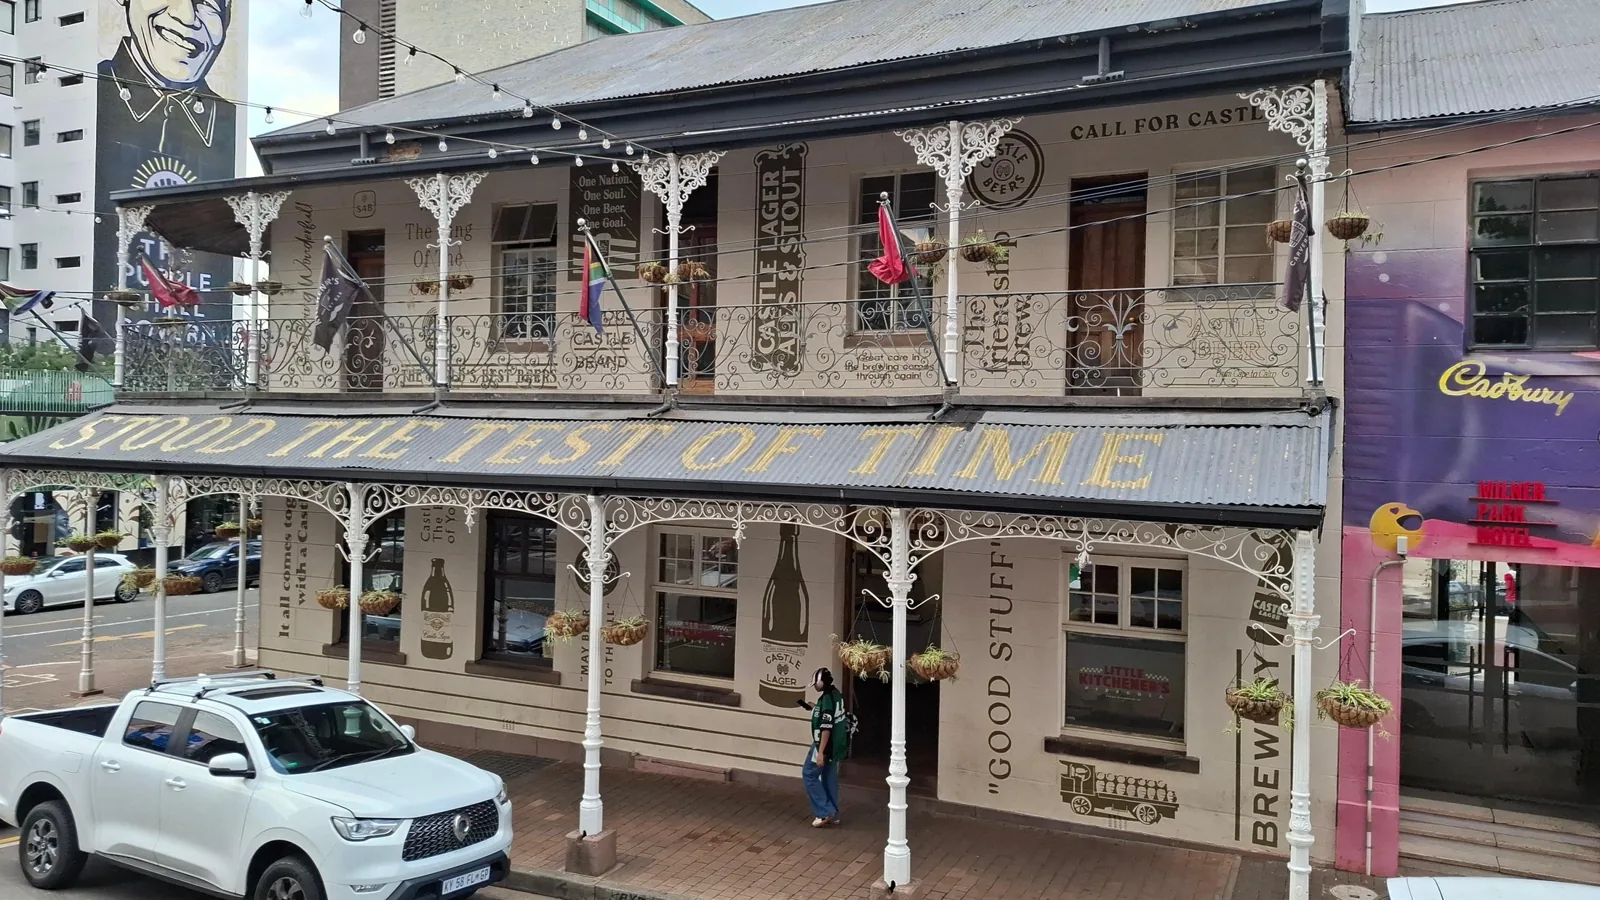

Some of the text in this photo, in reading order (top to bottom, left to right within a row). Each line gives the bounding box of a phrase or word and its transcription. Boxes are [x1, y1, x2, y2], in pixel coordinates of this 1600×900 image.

[1070, 104, 1268, 141] CALL FOR CASTL
[579, 173, 632, 187] One Nation.
[983, 174, 1025, 195] BEERS
[584, 188, 626, 201] One Soul.
[356, 203, 373, 212] SAB
[583, 203, 626, 215] One Beer.
[781, 166, 801, 254] STOUT
[602, 217, 626, 228] Goal.
[405, 223, 473, 242] The ing
[413, 249, 431, 268] Of
[757, 170, 780, 354] CASTLE LAGER
[778, 262, 798, 282] &
[962, 299, 986, 354] The
[573, 332, 631, 346] CASTLE
[911, 353, 920, 361] in
[1250, 370, 1258, 378] to
[1438, 359, 1575, 417] Cadbury
[48, 414, 1165, 490] STOOD THE TEST OF TIME
[1478, 480, 1546, 501] MILNER
[1477, 503, 1527, 522] PARK
[432, 517, 443, 543] The
[444, 527, 455, 544] of
[298, 547, 307, 558] a
[282, 533, 292, 592] comes
[295, 562, 307, 606] with
[279, 596, 290, 620] all
[278, 623, 290, 638] It
[765, 653, 802, 670] CASTLE
[604, 668, 613, 686] TO
[766, 673, 797, 686] LAGER
[1104, 665, 1144, 679] LITTLE
[443, 879, 454, 893] KY
